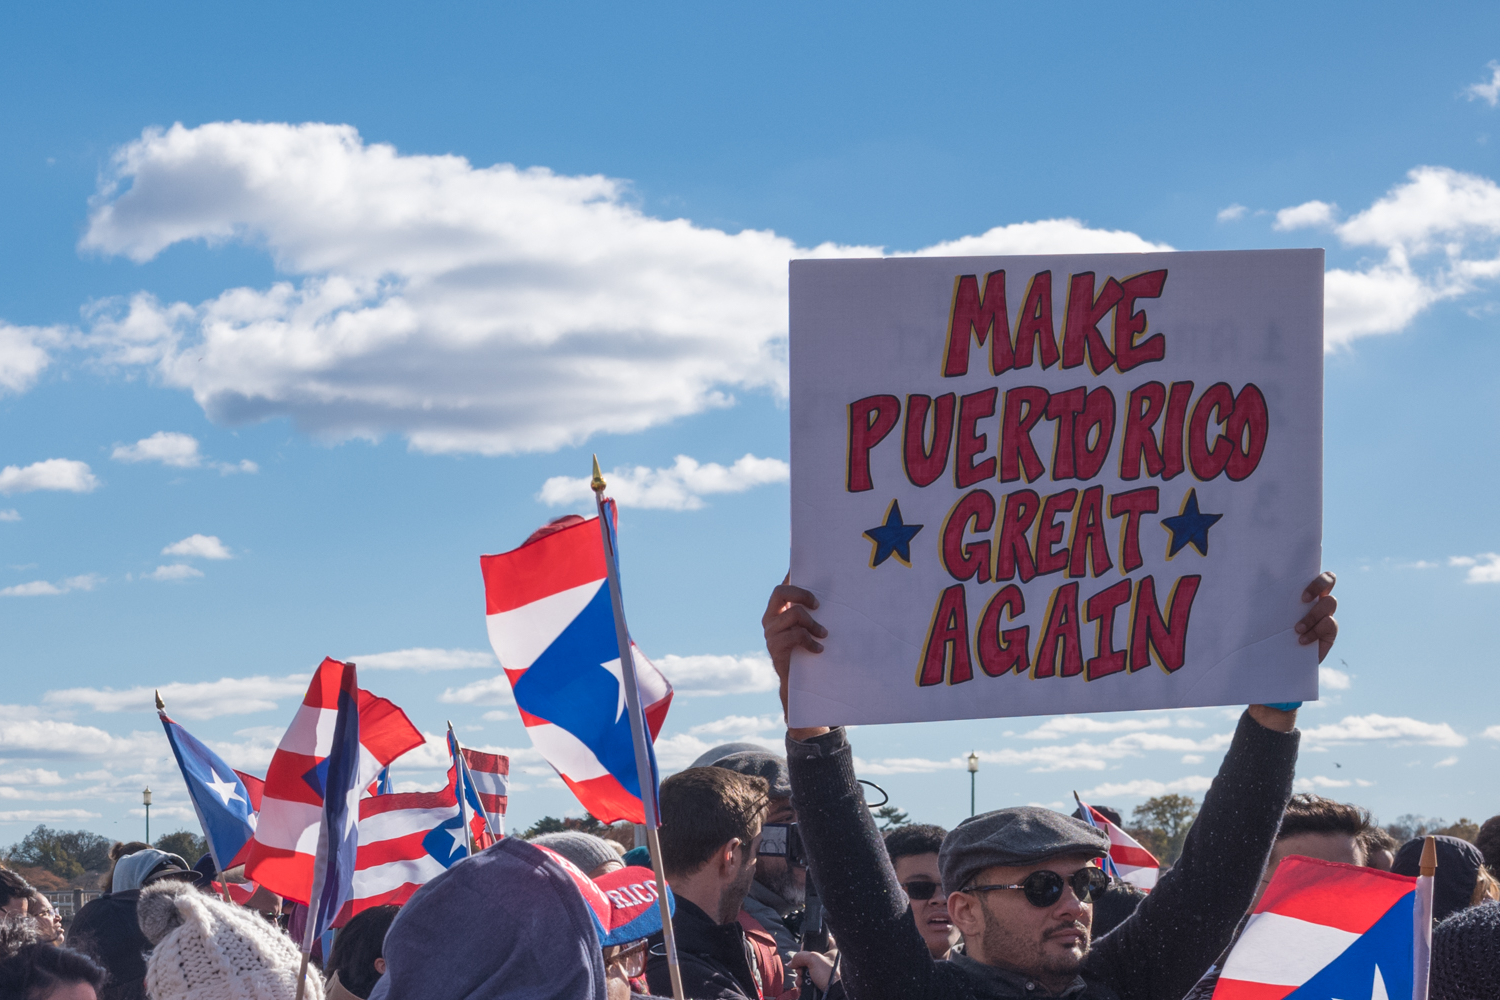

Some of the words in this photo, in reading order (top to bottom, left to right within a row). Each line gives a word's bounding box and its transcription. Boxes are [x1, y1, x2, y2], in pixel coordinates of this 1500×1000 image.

[942, 269, 1168, 377] MAKE
[846, 385, 1116, 493] PUERTO
[1120, 381, 1269, 482] RICO
[940, 485, 1160, 584] GREAT
[916, 575, 1201, 687] AGAIN
